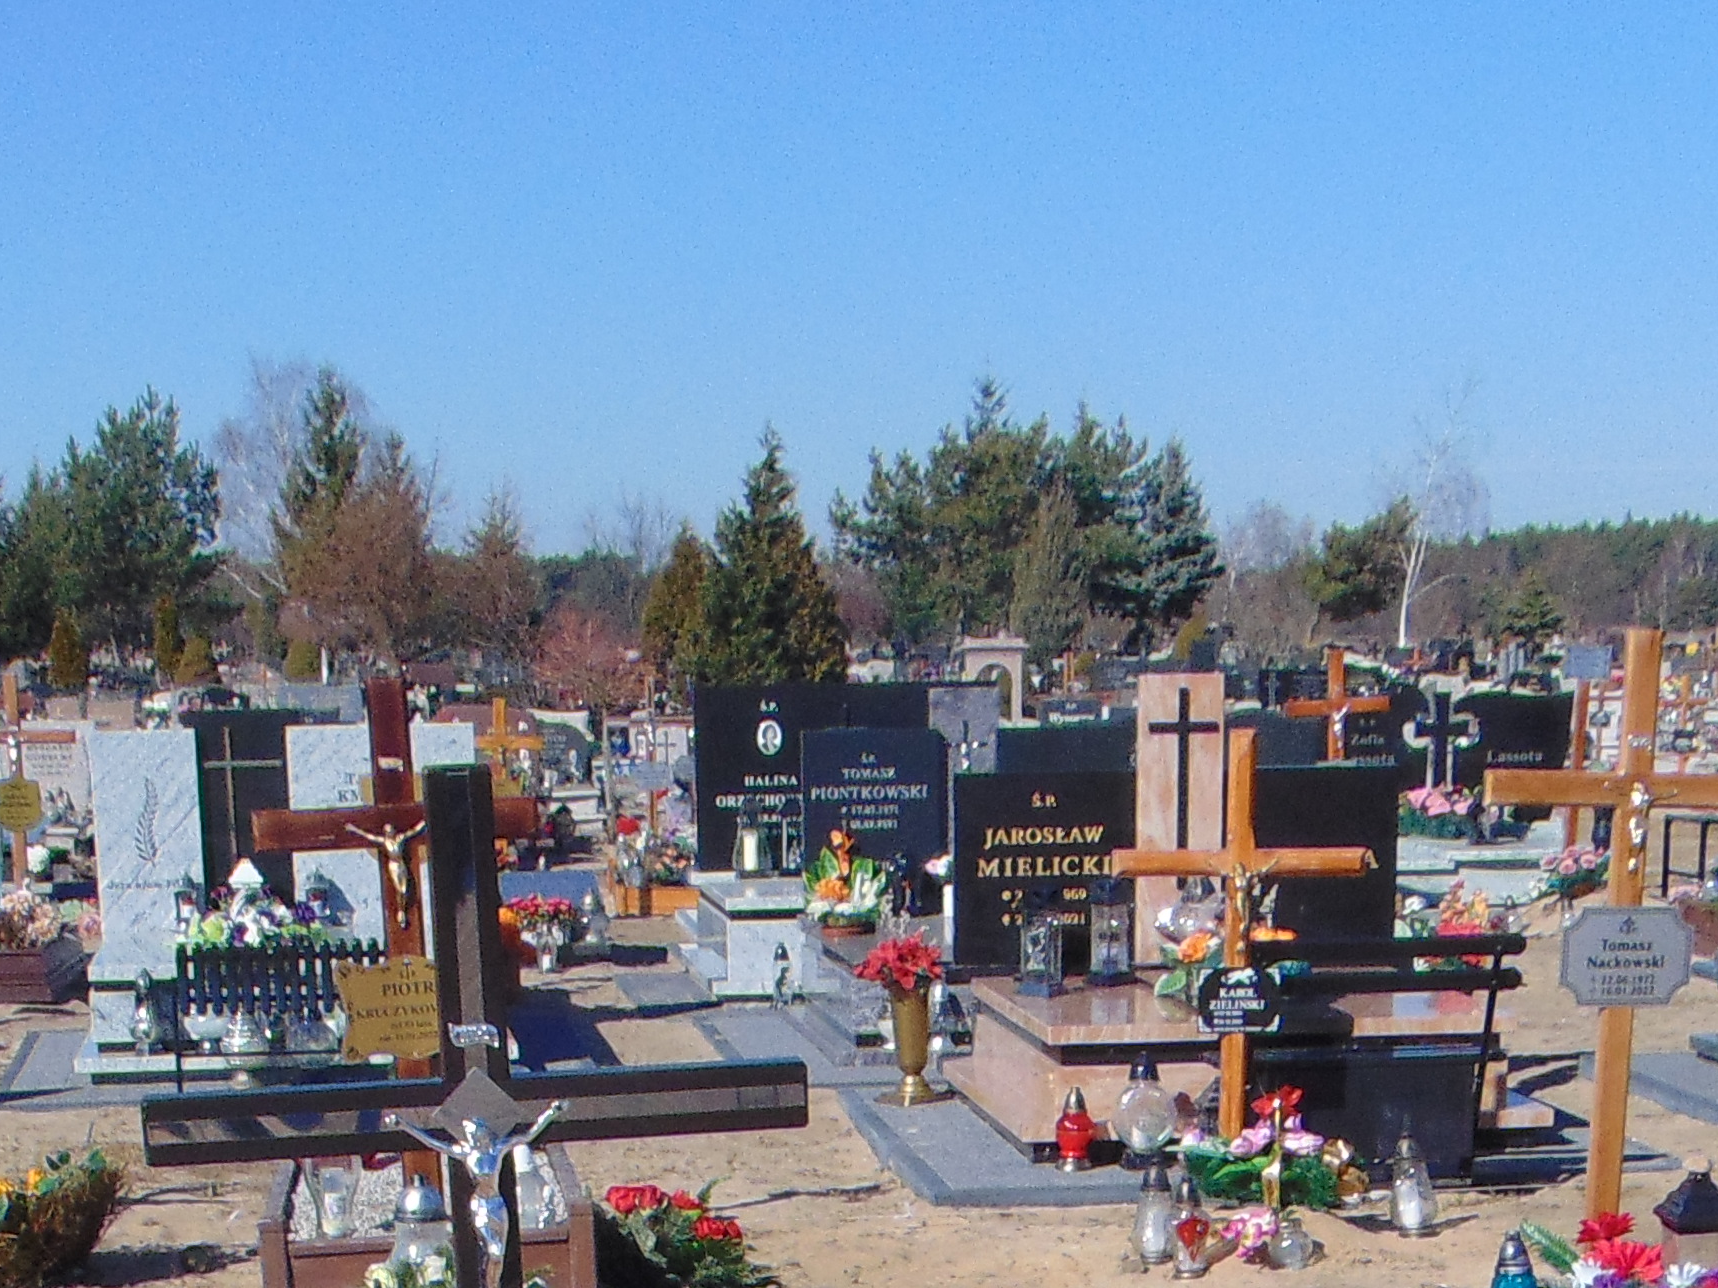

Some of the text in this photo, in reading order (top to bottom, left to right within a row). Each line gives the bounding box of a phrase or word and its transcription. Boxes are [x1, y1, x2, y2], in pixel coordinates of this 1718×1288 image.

[1486, 750, 1544, 763] Lassota
[841, 766, 897, 779] TOMASZ
[744, 774, 799, 787] HALINA
[811, 784, 929, 801] PIONTKOWSKI
[985, 825, 1105, 849] JAROSŁAW
[977, 854, 1112, 879] MIELICKI
[1601, 939, 1653, 951] Tomasz
[382, 980, 434, 997] PIOTR
[1219, 987, 1257, 998] KAROL
